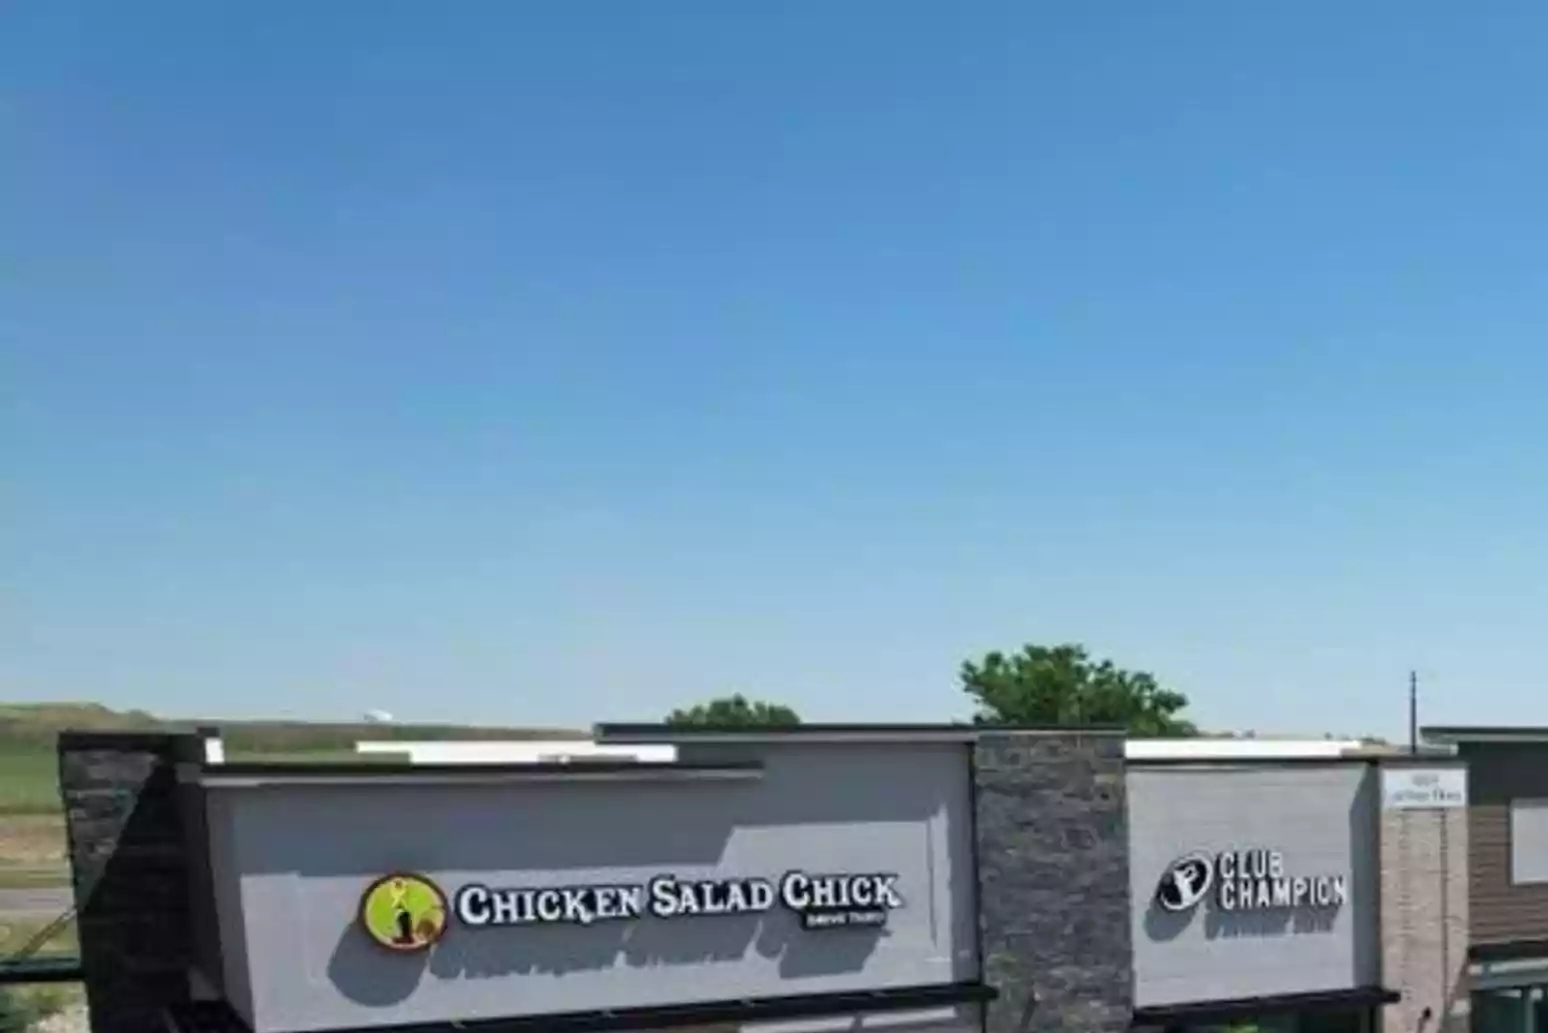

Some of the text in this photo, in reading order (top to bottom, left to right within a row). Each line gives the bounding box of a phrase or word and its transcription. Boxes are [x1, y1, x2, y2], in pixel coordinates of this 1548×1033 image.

[1218, 851, 1284, 879] CLUB
[459, 872, 902, 925] CHICKEN SALAD CHICK
[1220, 874, 1348, 910] CHAMPION
